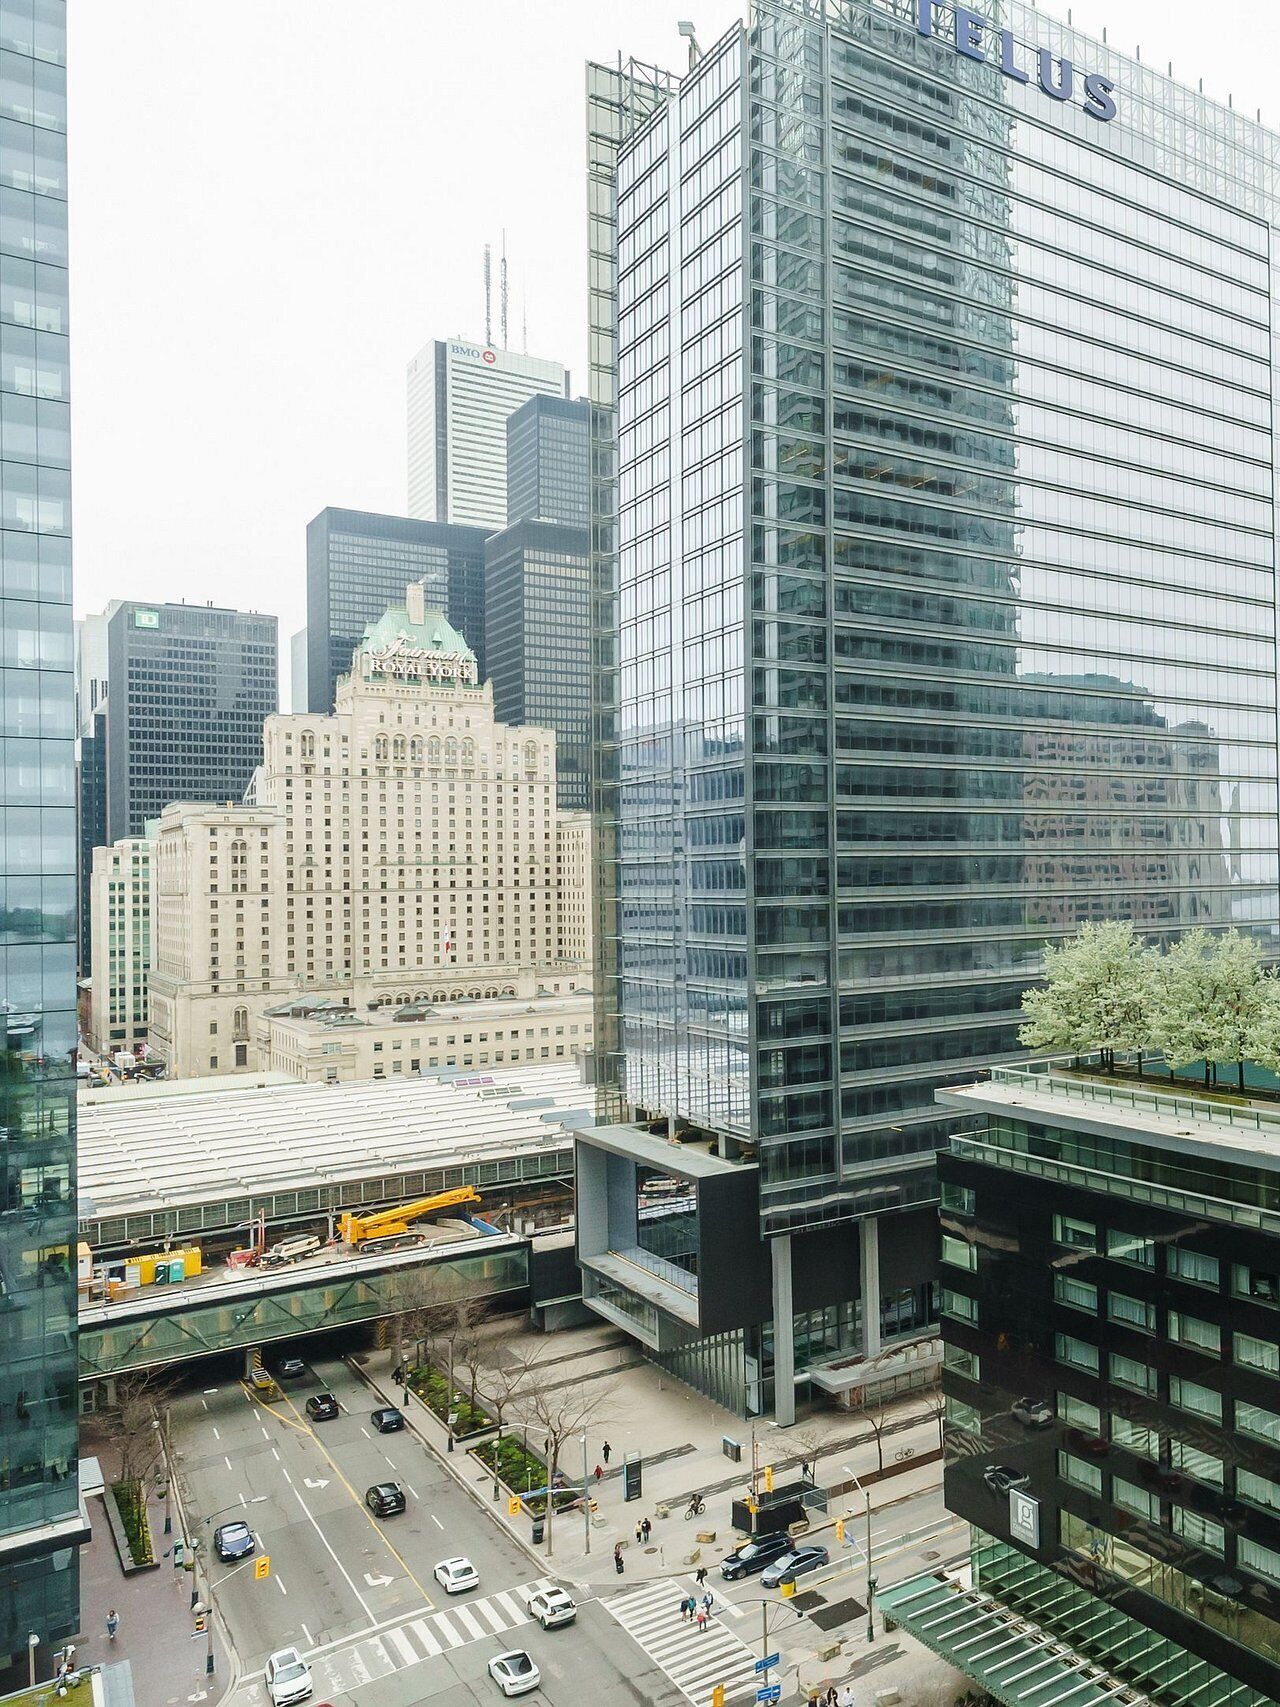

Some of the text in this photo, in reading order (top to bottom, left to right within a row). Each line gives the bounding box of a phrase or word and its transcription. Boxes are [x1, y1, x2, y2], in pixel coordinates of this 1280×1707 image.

[451, 344, 481, 359] BMO
[369, 633, 475, 666] Fairmont
[370, 659, 422, 675] ROYAL
[427, 662, 474, 679] YORK
